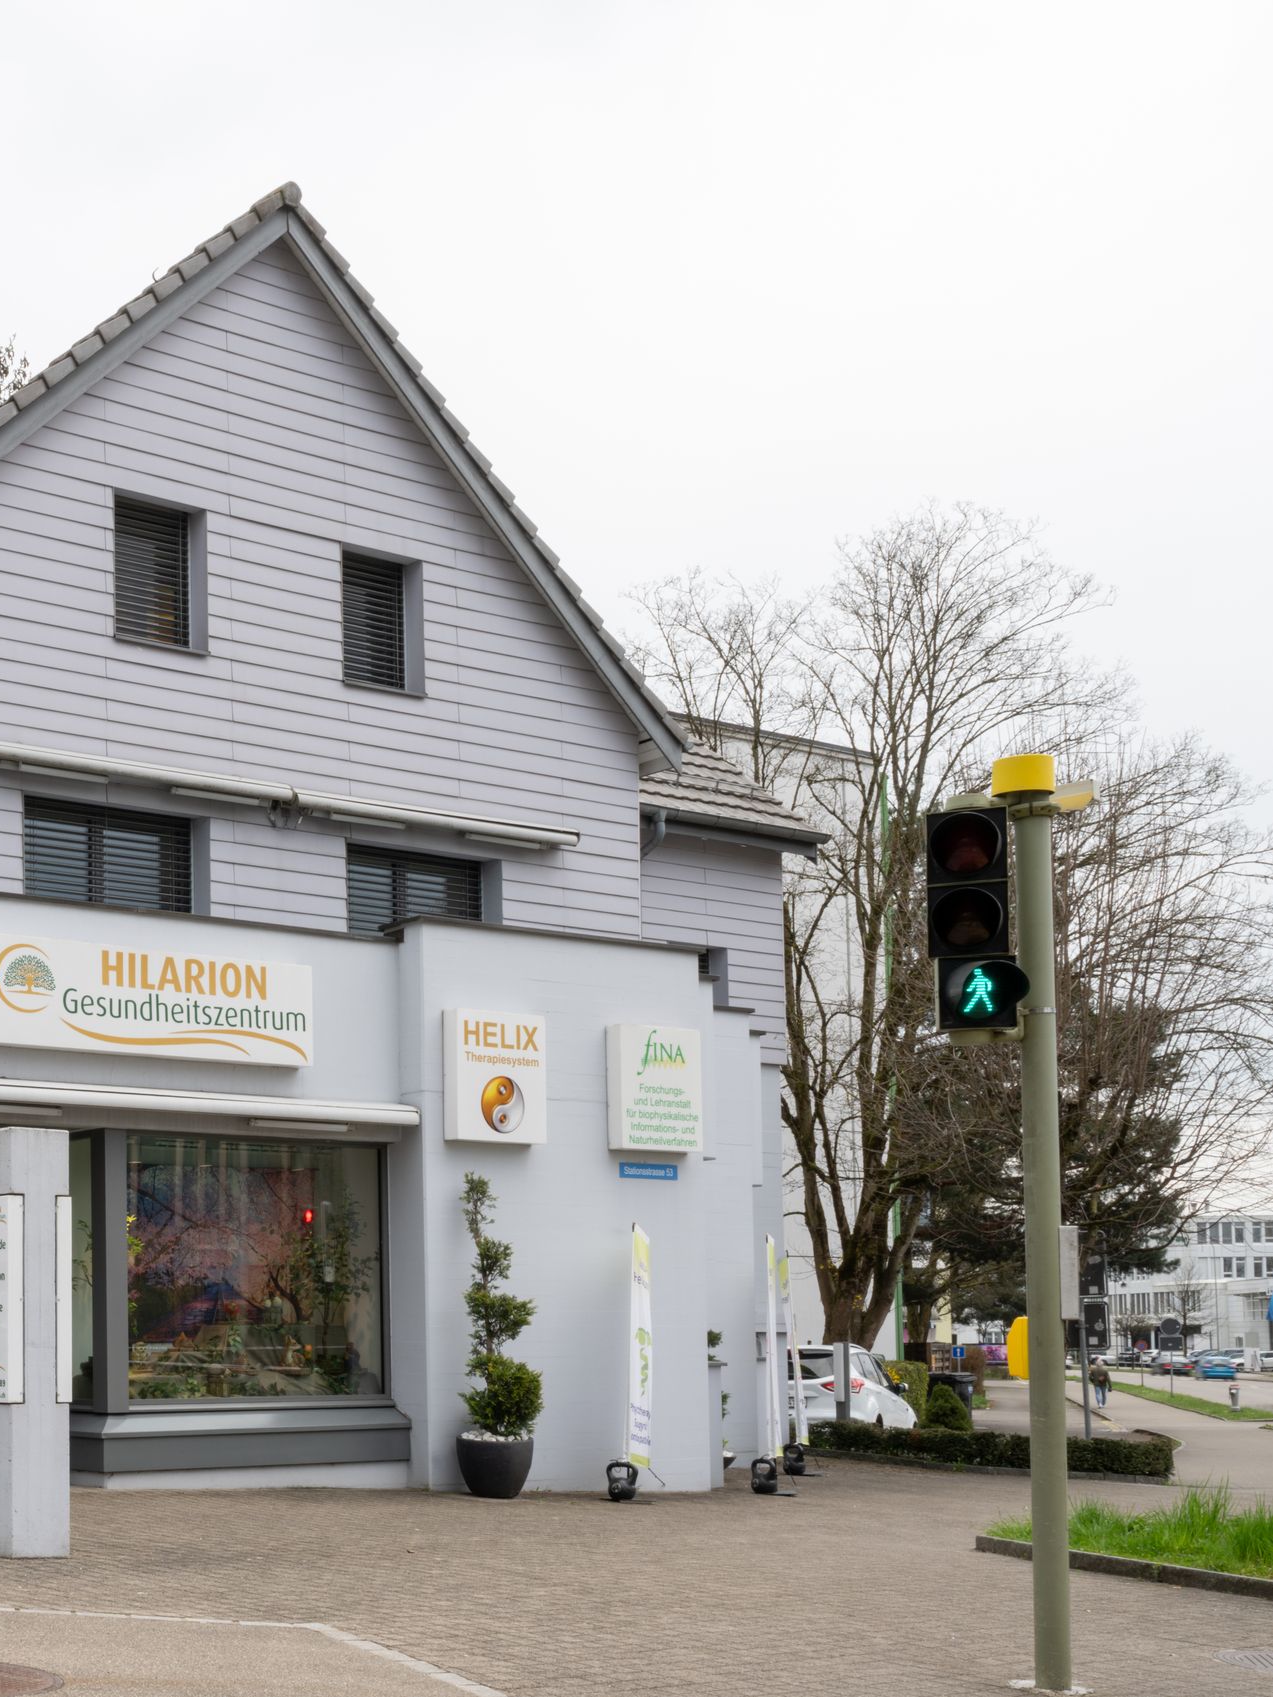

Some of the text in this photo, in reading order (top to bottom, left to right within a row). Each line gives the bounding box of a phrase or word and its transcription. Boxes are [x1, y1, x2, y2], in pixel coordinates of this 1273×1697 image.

[101, 950, 267, 1000] HILARION
[62, 987, 306, 1032] Gesundheitszentrum
[463, 1019, 538, 1052] HELIX
[465, 1051, 539, 1067] Therapiesystem
[639, 1083, 685, 1097] Forschungs-
[633, 1097, 691, 1109] und Lehranstalt
[626, 1108, 699, 1122] für biophysikalische
[630, 1122, 696, 1135] Informations- und
[629, 1135, 698, 1147] Naturheilverfahren
[624, 1166, 673, 1177] Stationsstrasse 53
